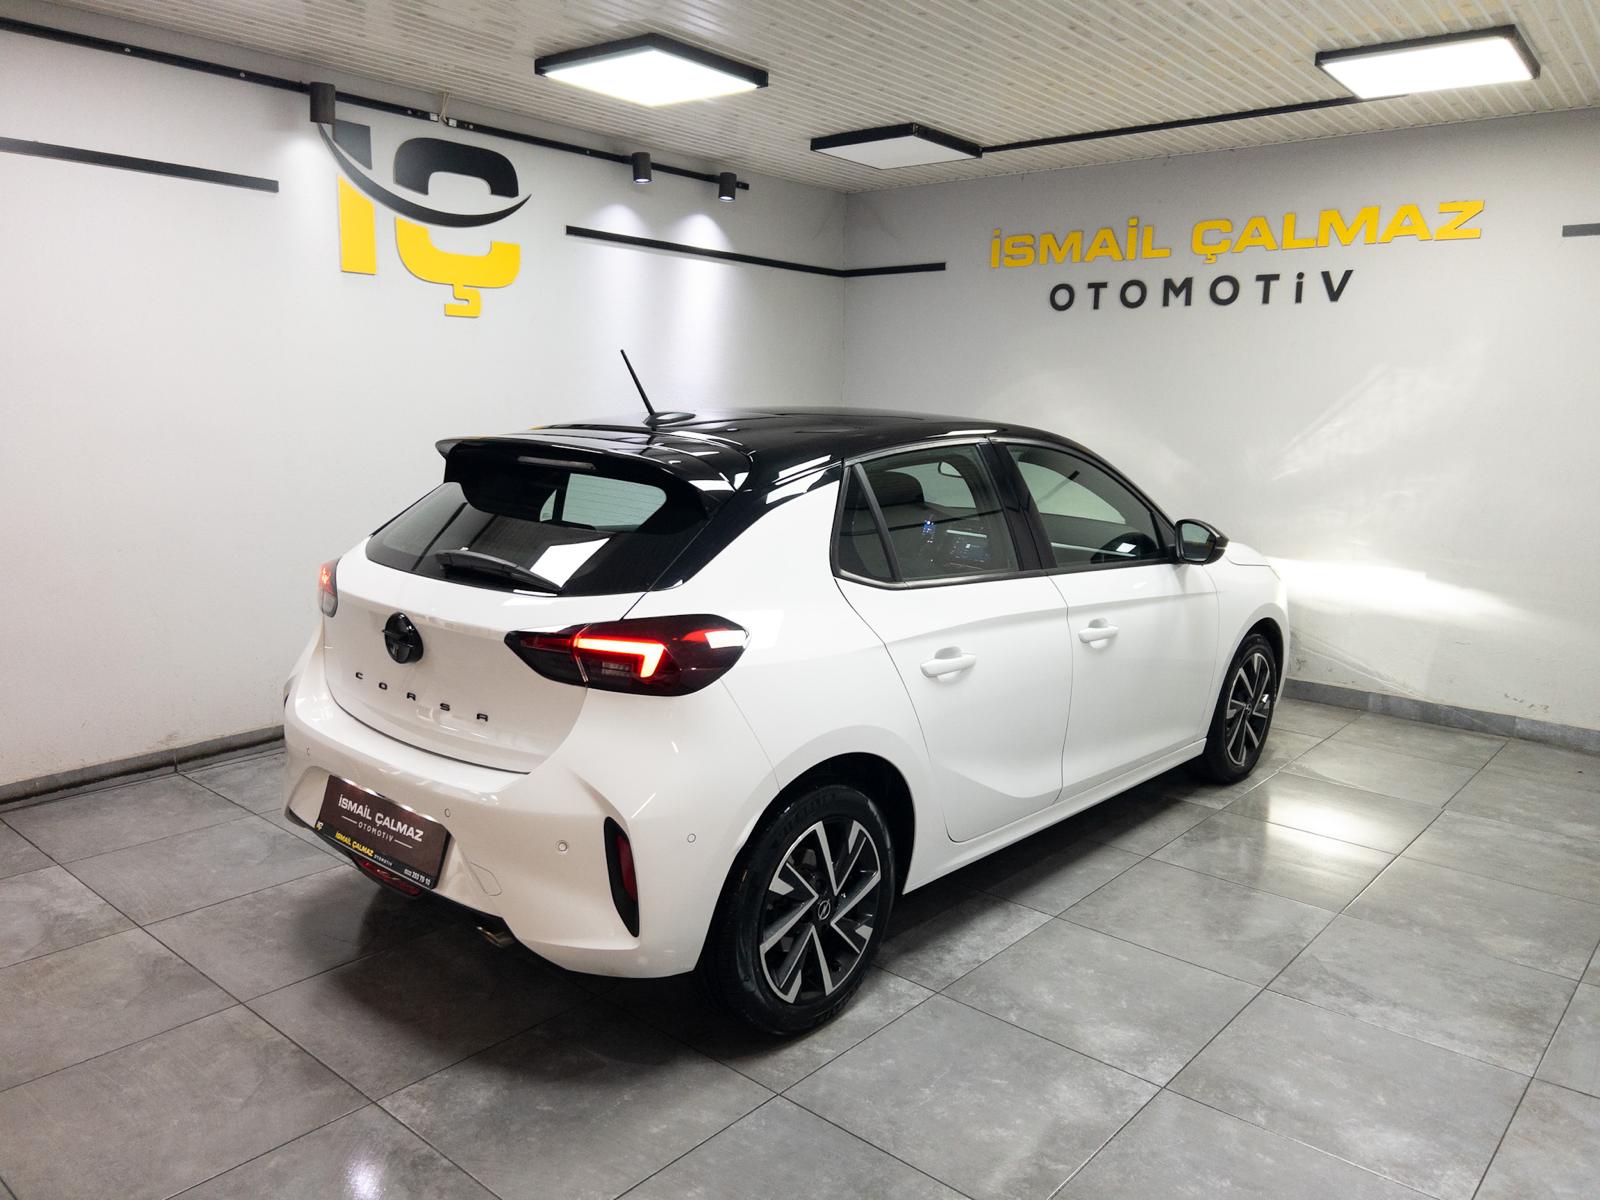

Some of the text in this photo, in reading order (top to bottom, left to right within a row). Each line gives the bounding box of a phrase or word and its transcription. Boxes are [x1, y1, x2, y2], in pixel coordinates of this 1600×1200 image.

[990, 199, 1485, 269] İSMAİL ÇALMAZ
[355, 671, 489, 722] CORSA
[338, 794, 424, 842] İSMAİL ÇALMAZ
[351, 840, 374, 857] ÇALMAZ
